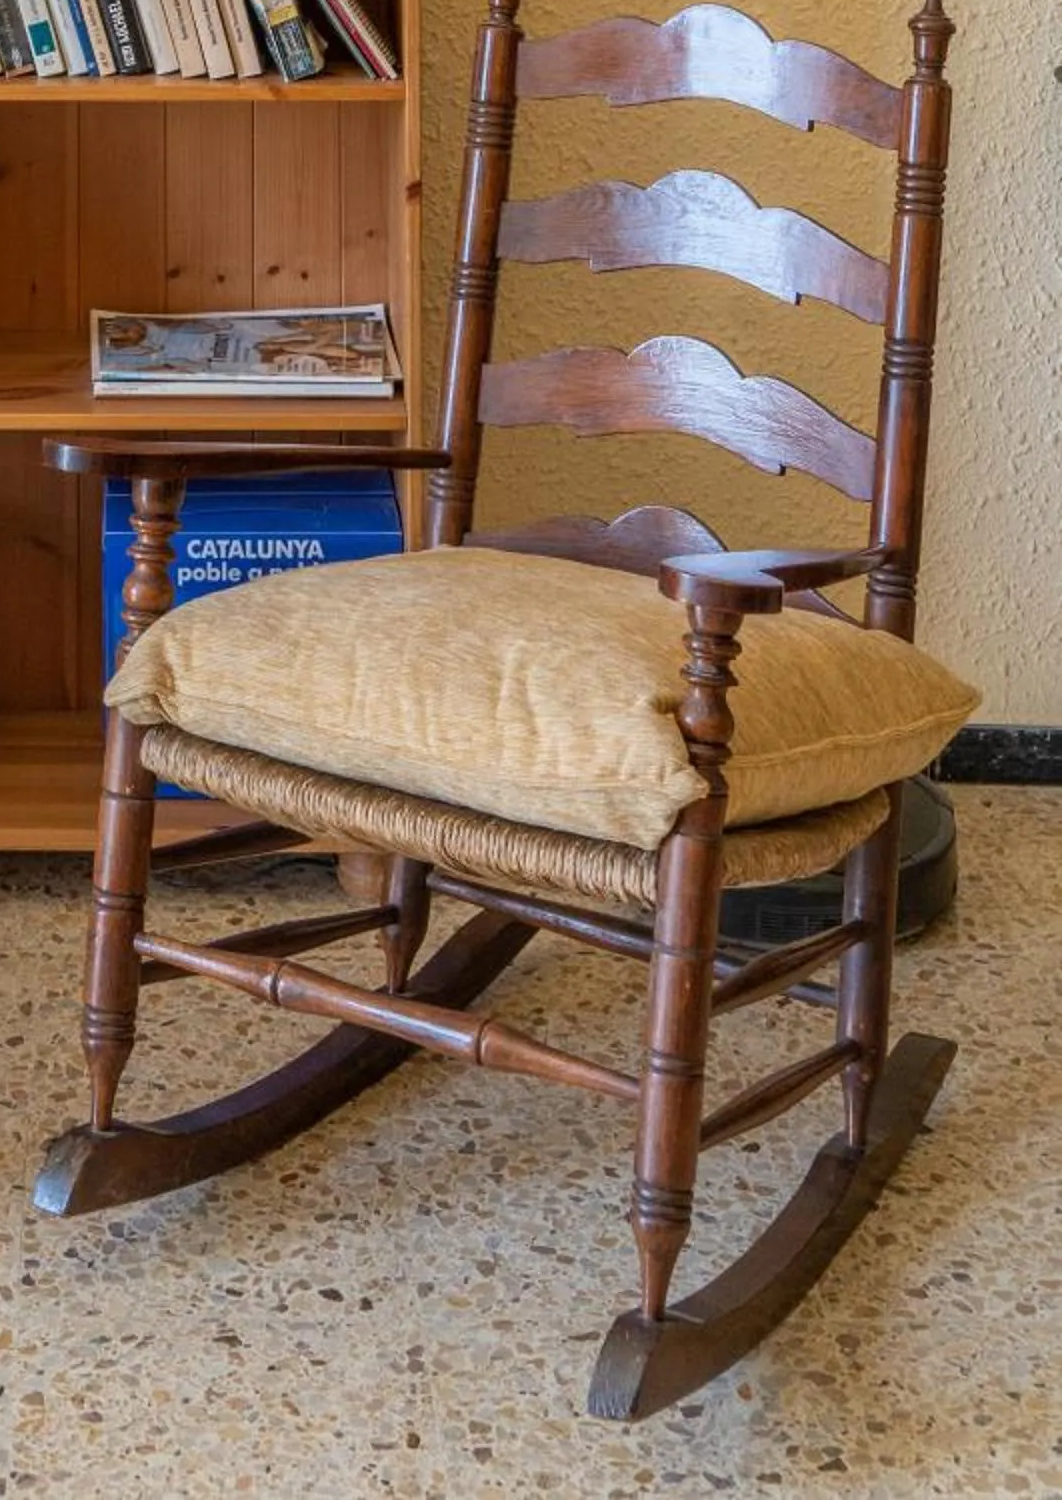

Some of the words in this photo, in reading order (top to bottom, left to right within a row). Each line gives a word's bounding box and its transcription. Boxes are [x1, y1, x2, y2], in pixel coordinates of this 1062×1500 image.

[109, 0, 130, 44] MICHAEL
[187, 539, 324, 559] CATALUNYA
[177, 562, 241, 587] poble
[248, 567, 262, 581] a
